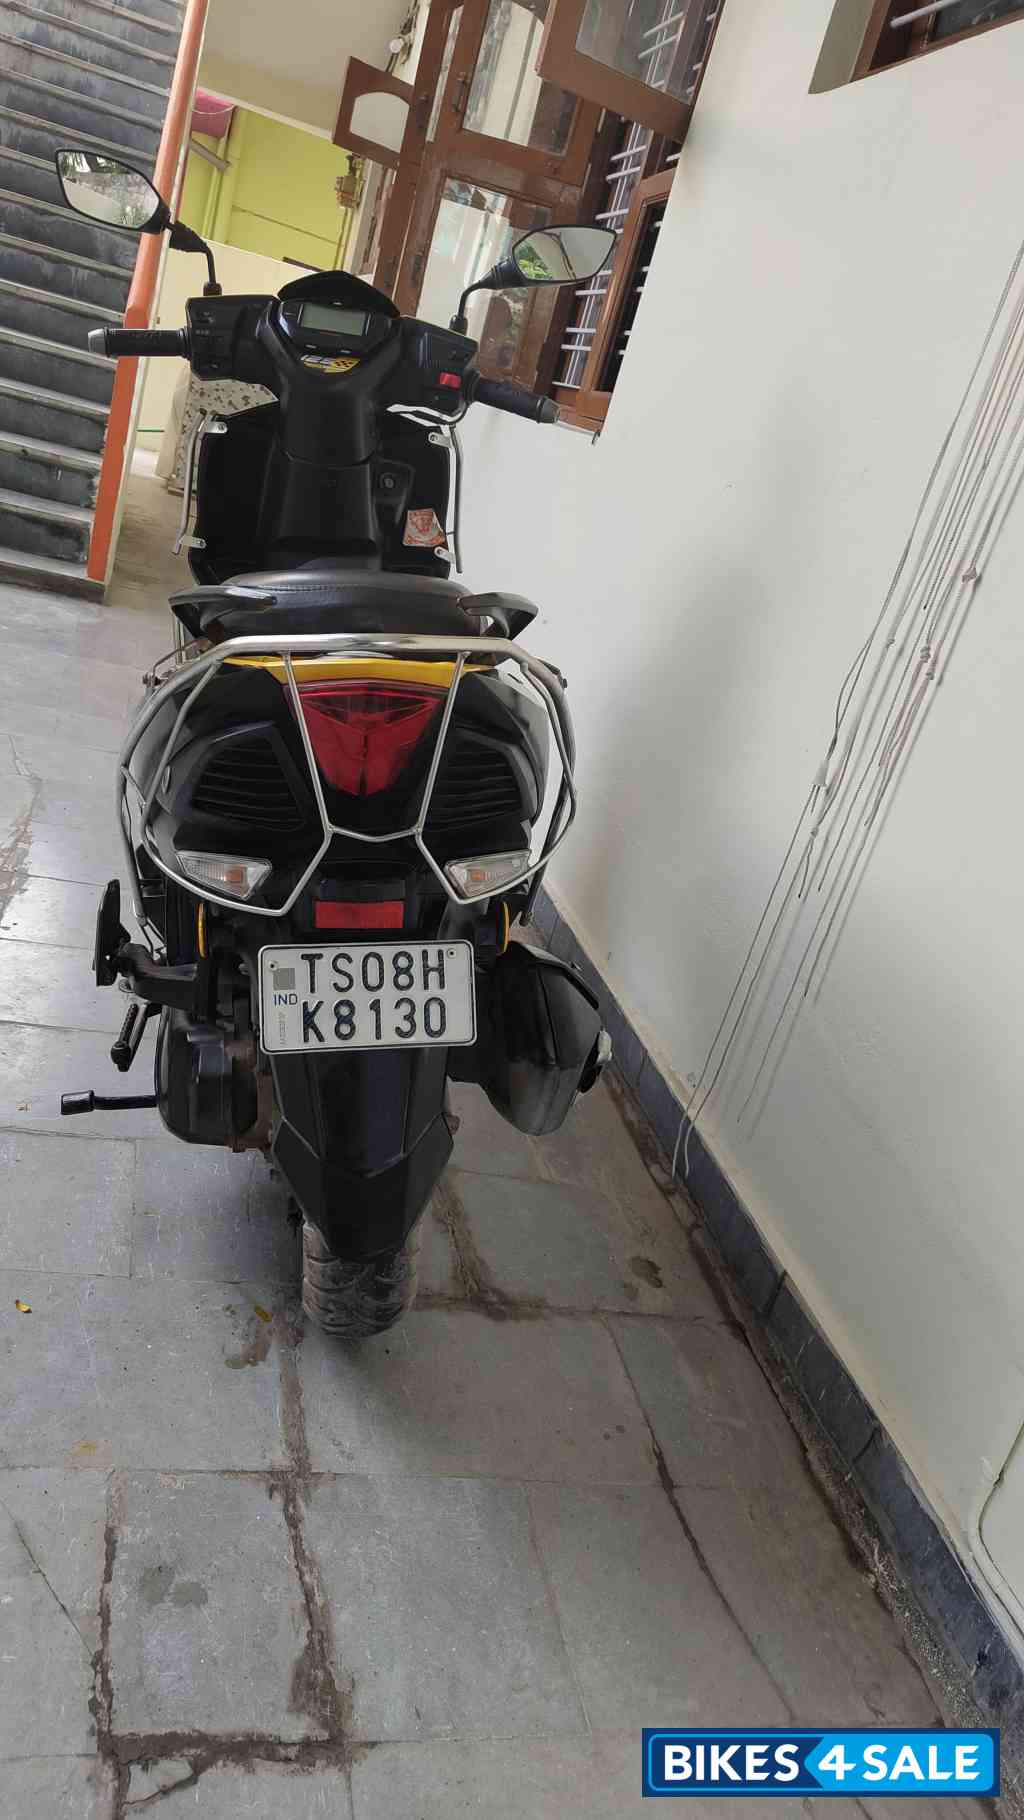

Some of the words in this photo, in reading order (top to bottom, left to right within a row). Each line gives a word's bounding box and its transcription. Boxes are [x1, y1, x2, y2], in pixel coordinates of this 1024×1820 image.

[301, 949, 445, 994] TS08H
[273, 993, 298, 1006] IND
[302, 997, 447, 1043] K8130
